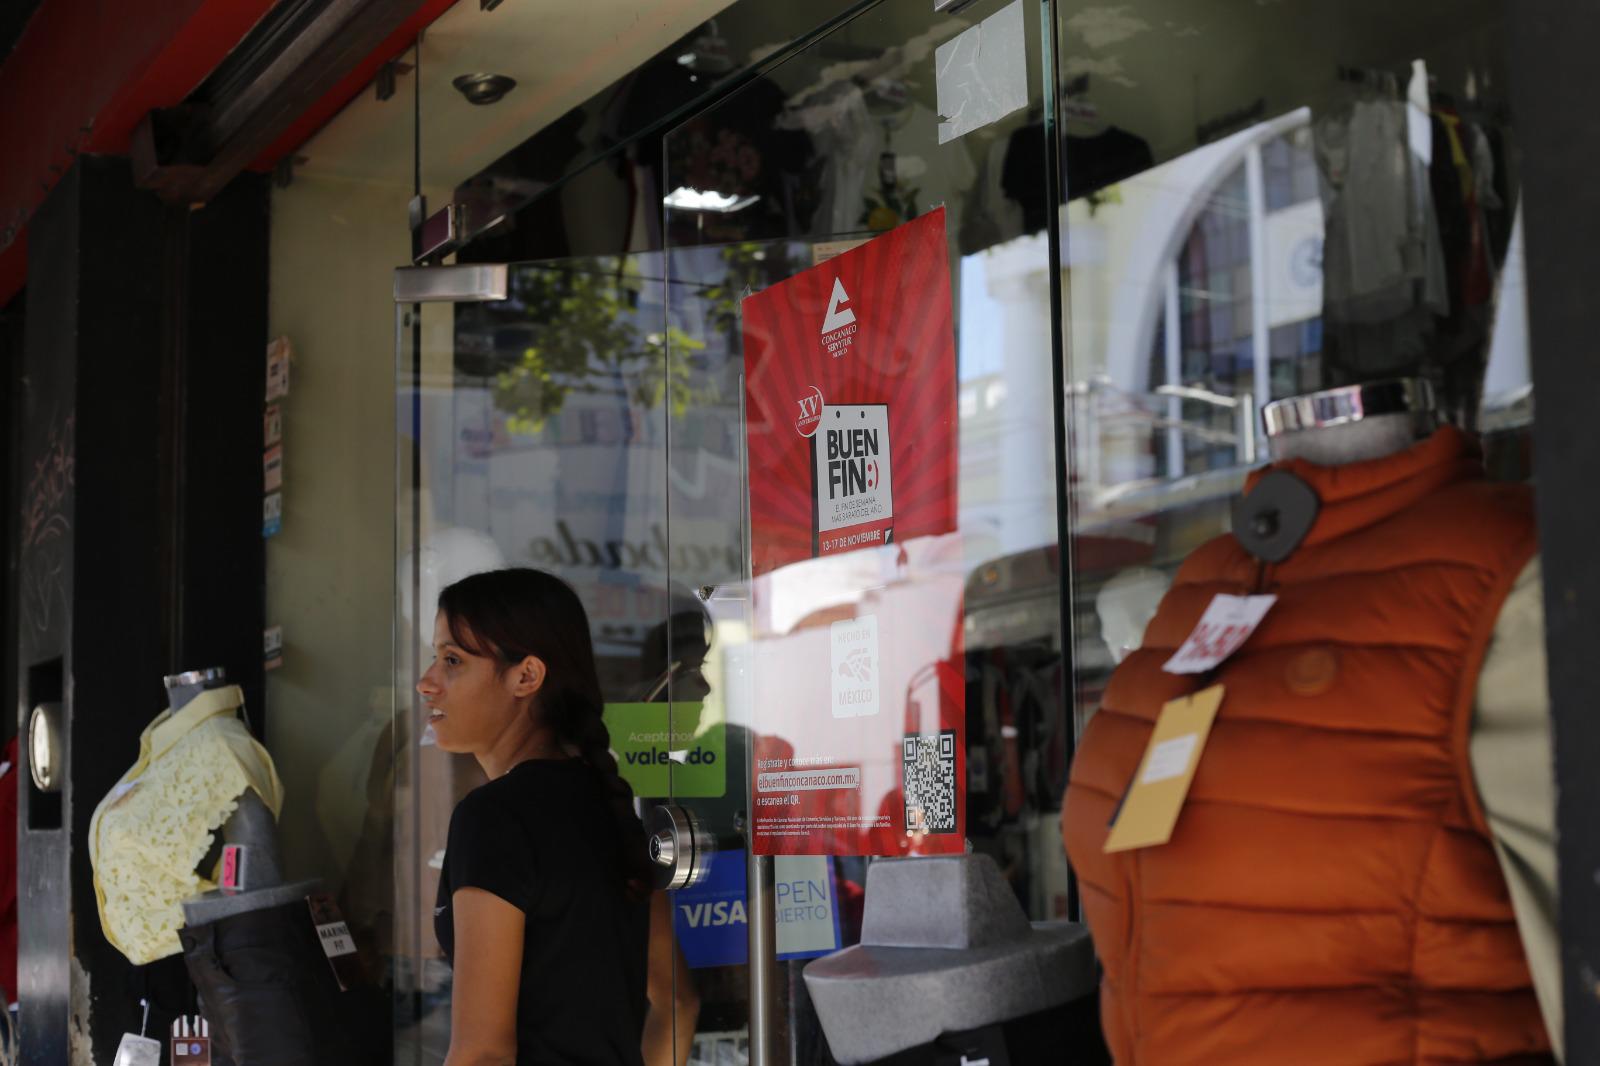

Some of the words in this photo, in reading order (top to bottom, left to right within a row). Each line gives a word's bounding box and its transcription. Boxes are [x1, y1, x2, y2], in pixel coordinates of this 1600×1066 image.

[821, 324, 857, 346] CONCANACO
[797, 394, 820, 420] XV
[826, 428, 879, 461] BUEN
[855, 496, 876, 509] SEMANA
[822, 540, 838, 552] 13-17
[839, 537, 848, 548] DE
[847, 530, 881, 547] NOVIEMBRE
[758, 773, 856, 789] elbuenfinconcanaco.com.mx
[761, 796, 783, 806] escanea
[777, 879, 826, 905] PEN
[679, 899, 748, 929] VISA
